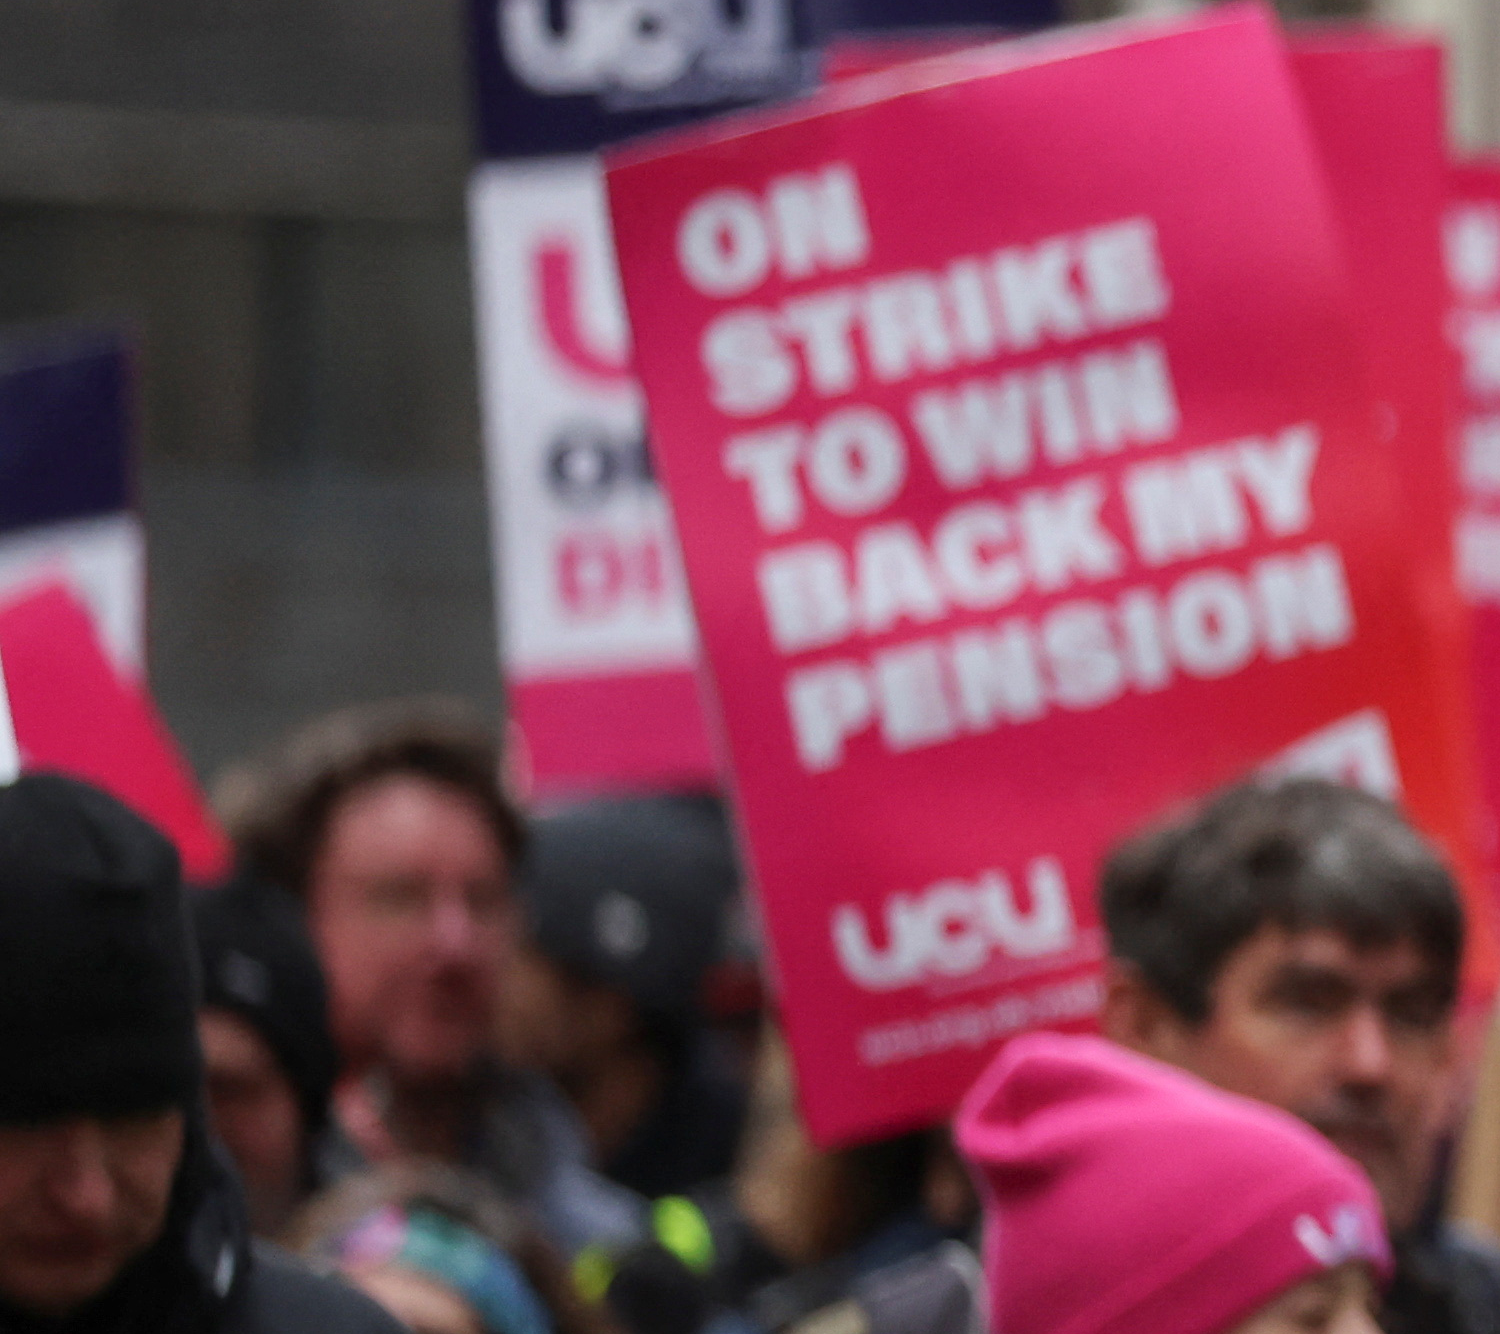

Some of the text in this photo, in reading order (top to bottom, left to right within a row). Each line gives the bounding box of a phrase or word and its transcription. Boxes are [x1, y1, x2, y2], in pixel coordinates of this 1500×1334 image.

[679, 164, 869, 294] ON
[702, 217, 1170, 415] STRIKE
[723, 408, 906, 533] TO
[913, 341, 1179, 492] WIN
[758, 478, 1123, 654] BACK
[1123, 426, 1319, 560] MY
[786, 545, 1355, 771] PENSION
